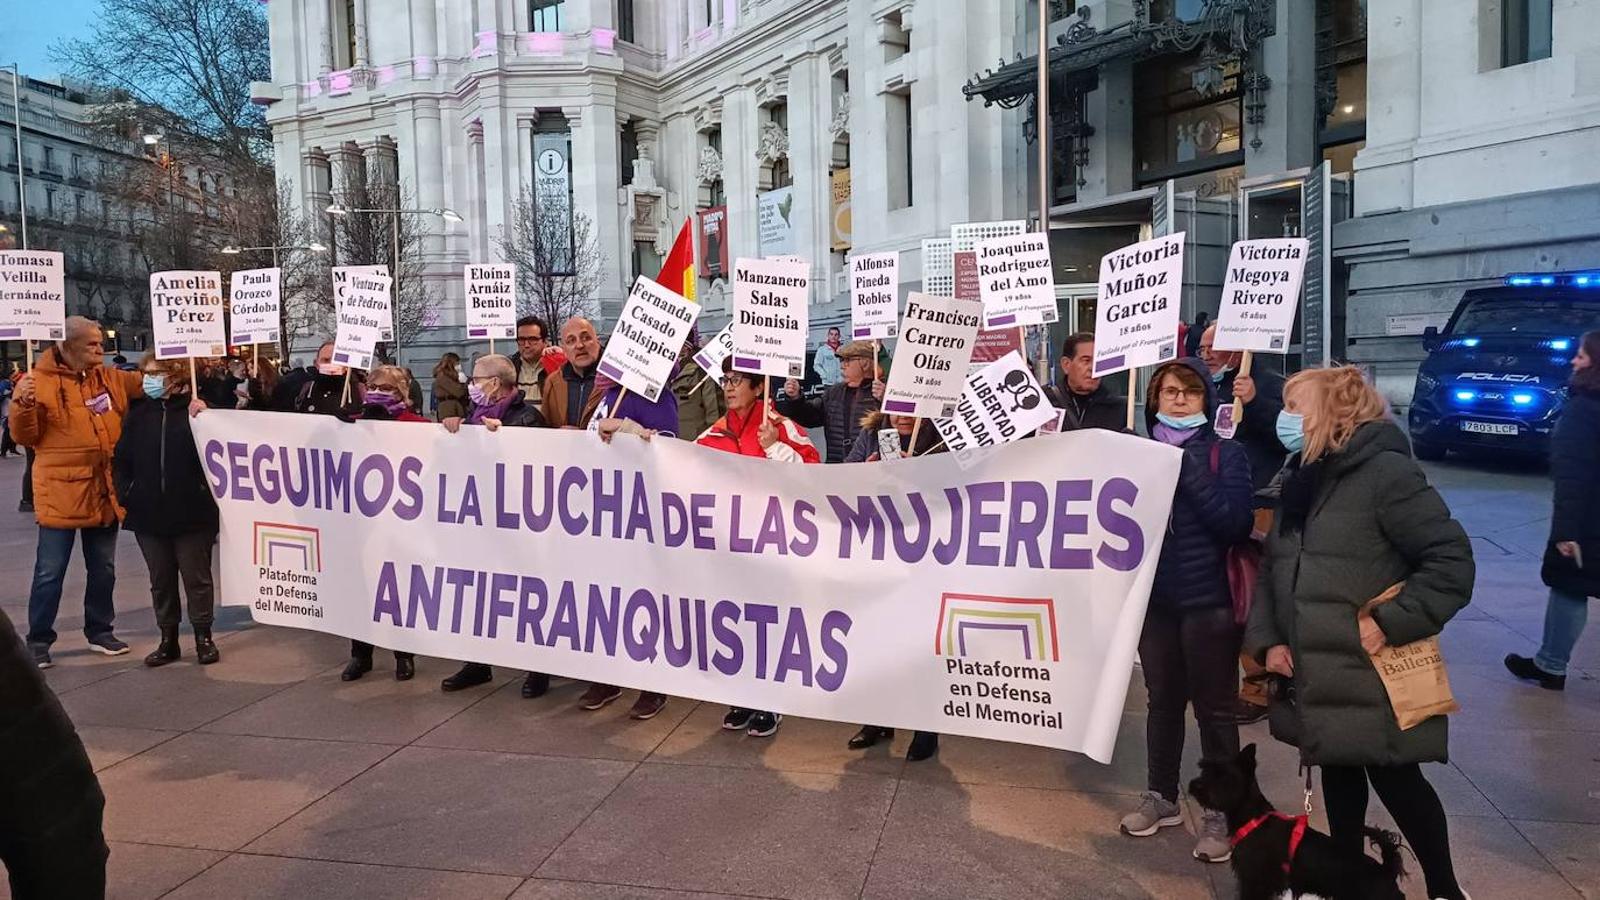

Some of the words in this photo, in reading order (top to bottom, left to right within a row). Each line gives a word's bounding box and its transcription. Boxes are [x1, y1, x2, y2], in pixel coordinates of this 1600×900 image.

[981, 241, 1044, 258] Joaquina
[1108, 241, 1180, 274] Victoria
[1239, 244, 1301, 260] Victoria
[0, 254, 53, 267] Tomasa
[855, 258, 894, 272] Alfonsa
[980, 258, 1049, 276] Rodríguez
[1, 271, 47, 283] Velilla
[242, 272, 271, 285] Paula
[471, 267, 510, 280] Eloína
[736, 269, 807, 288] Manzanero
[855, 274, 890, 289] Pineda
[1230, 268, 1289, 286] Megoya
[155, 276, 217, 290] Amelia
[351, 276, 385, 292] Ventura
[468, 281, 511, 294] Arnáiz
[990, 278, 1011, 292] del
[1015, 276, 1047, 288] Amo
[1104, 271, 1168, 300] Muñoz
[153, 292, 220, 307] Treviño
[234, 289, 272, 300] Orozco
[346, 294, 357, 308] de
[357, 295, 383, 310] Pedro
[472, 296, 512, 309] Benito
[750, 289, 789, 308] Salas
[858, 291, 892, 306] Robles
[1232, 289, 1283, 305] Rivero
[232, 302, 277, 315] Córdoba
[632, 282, 693, 324] Fernanda
[1106, 294, 1168, 323] García
[167, 308, 215, 323] Pérez
[359, 315, 379, 328] Rosa
[631, 305, 676, 338] Casado
[740, 310, 799, 330] Dionisia
[906, 302, 979, 327] Francisca
[1119, 326, 1129, 336] 18
[1130, 323, 1152, 333] años
[616, 320, 677, 362] Malsipica
[764, 337, 782, 345] años
[905, 327, 965, 349] Carrero
[913, 353, 951, 371] Olías
[913, 375, 923, 384] 38
[925, 377, 942, 387] años
[205, 439, 424, 521] SEGUIMOS
[437, 473, 483, 526] LA
[495, 463, 655, 544] LUCHA
[661, 492, 716, 550] DE
[729, 494, 819, 557] LAS
[825, 477, 1145, 571] MUJERES
[259, 567, 317, 585] Plataforma
[260, 586, 273, 596] en
[276, 585, 318, 601] Defensa
[255, 598, 271, 611] del
[273, 600, 323, 618] Memorial
[373, 561, 853, 692] ANTIFRANQUISTAS
[1390, 649, 1406, 660] de
[1408, 643, 1423, 655] la
[946, 658, 1050, 681] Plataforma
[1381, 654, 1441, 676] Ballena
[950, 683, 972, 696] en
[977, 681, 1052, 704] Defensa
[943, 700, 970, 718] del
[976, 703, 1063, 729] Memorial
